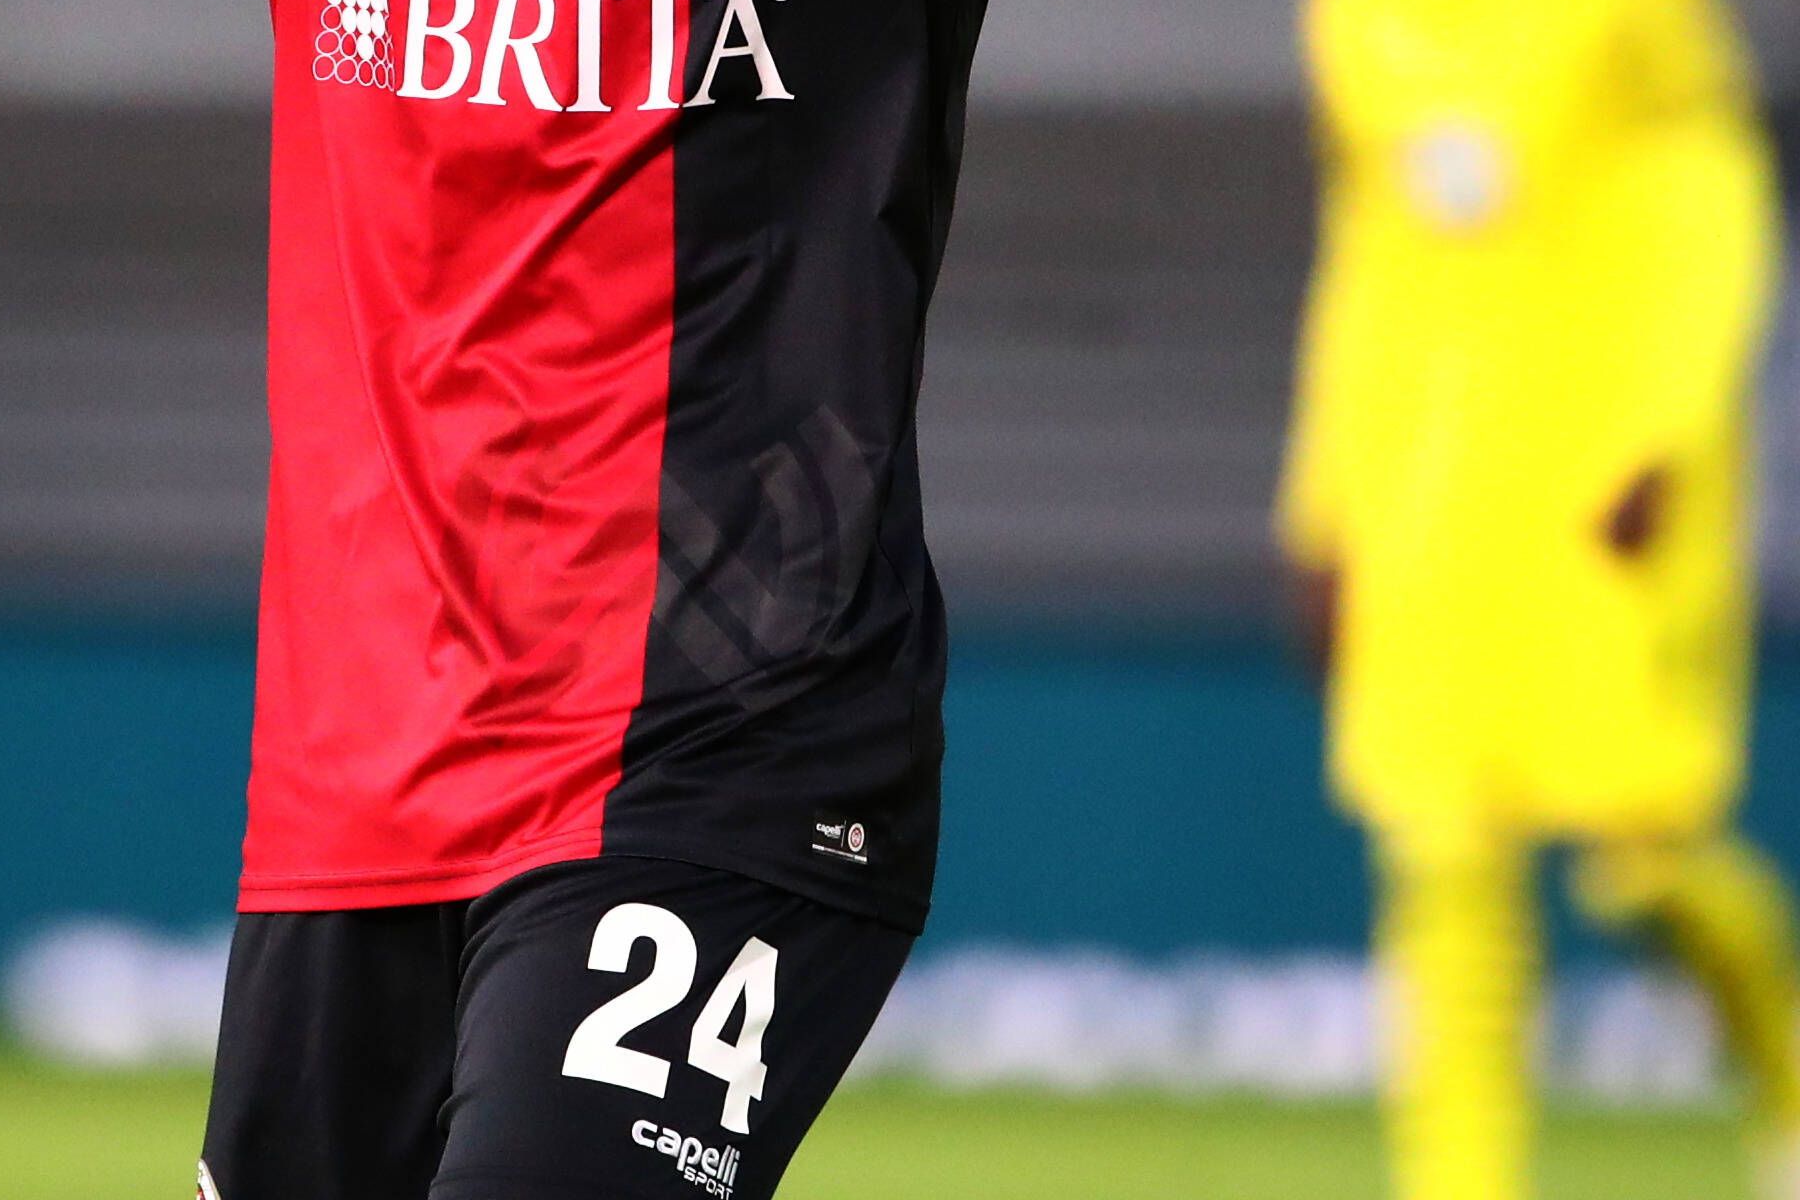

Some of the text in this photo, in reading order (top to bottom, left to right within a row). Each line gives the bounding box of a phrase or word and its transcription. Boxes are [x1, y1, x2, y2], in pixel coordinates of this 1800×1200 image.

[562, 902, 779, 1135] 24
[631, 1119, 741, 1187] capelli
[683, 1167, 734, 1200] SPORT
